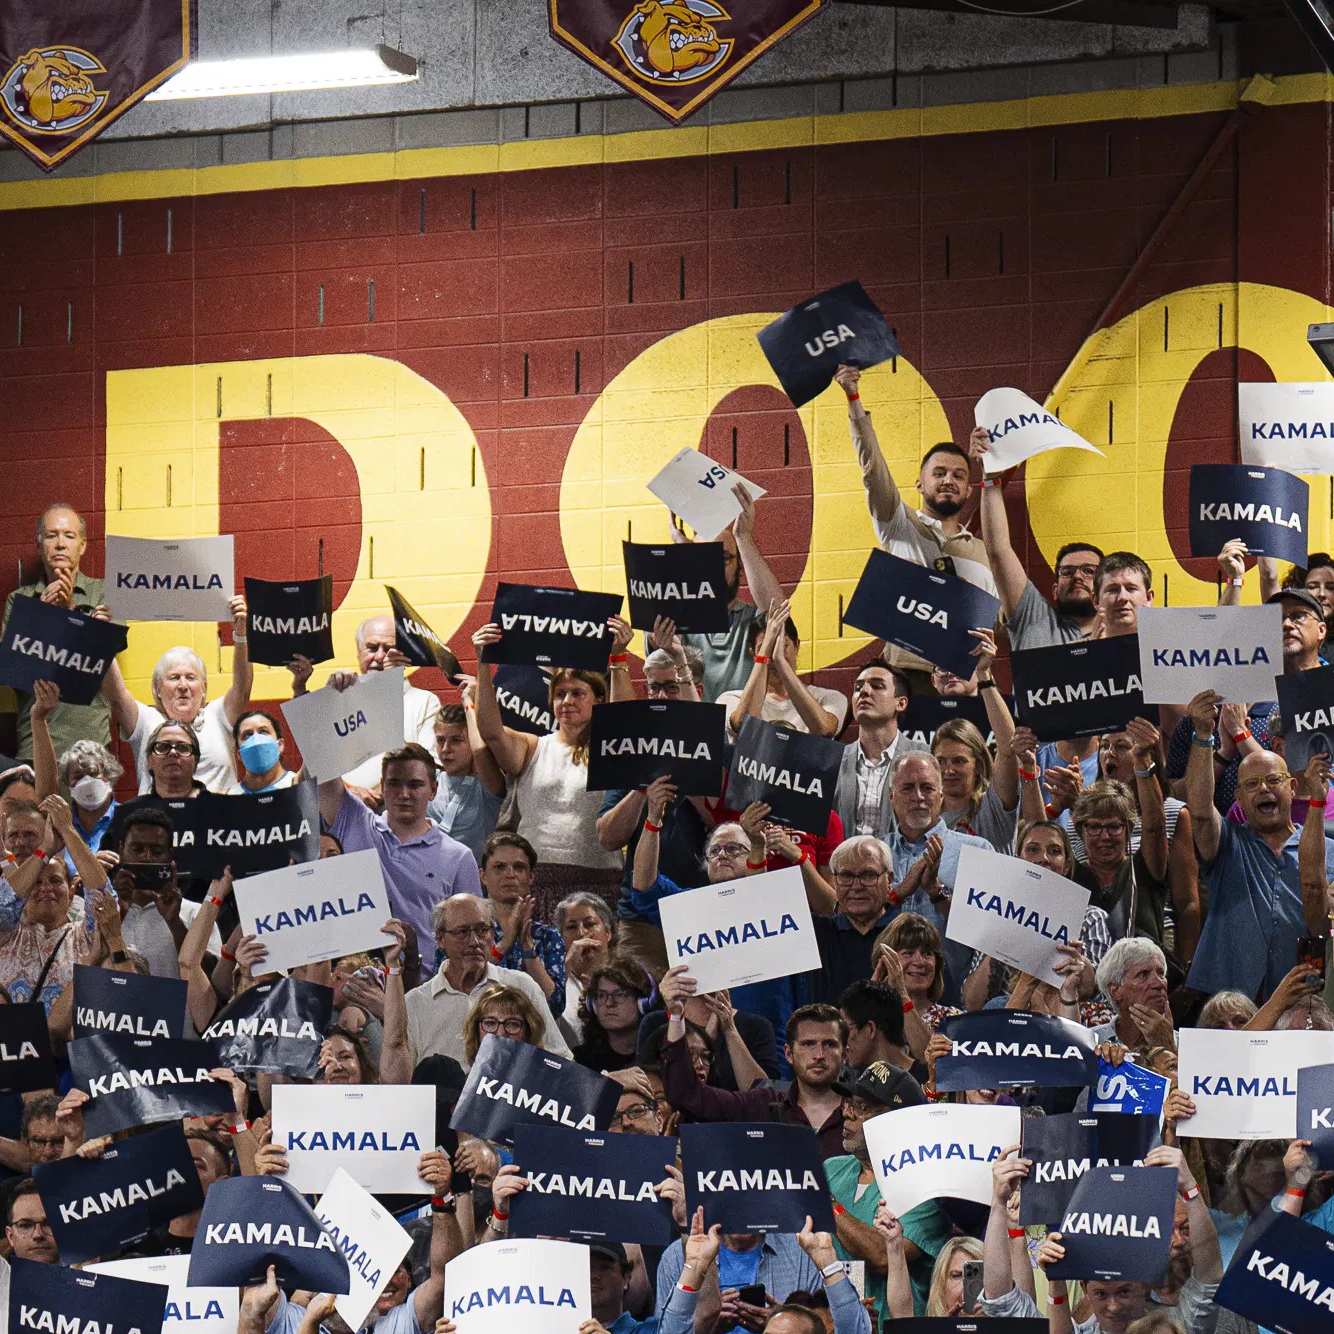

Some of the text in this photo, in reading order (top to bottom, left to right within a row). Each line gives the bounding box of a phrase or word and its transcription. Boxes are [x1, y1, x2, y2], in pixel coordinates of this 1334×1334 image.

[805, 322, 859, 356] USA
[987, 412, 1067, 443] KAMAL
[698, 465, 733, 490] SA
[1199, 502, 1302, 533] KAMALA
[117, 571, 221, 590] KAMALA
[630, 579, 716, 600] KAMALA
[252, 612, 329, 635] KAMALA
[501, 612, 605, 639] KAMALA
[896, 596, 949, 630] USA
[12, 634, 105, 675] KAMALA
[1153, 646, 1268, 667] KAMALA
[1027, 675, 1143, 708] KAMALA
[333, 710, 367, 737] USA
[495, 687, 560, 735] KAMAL
[600, 737, 711, 761] KAMALA
[737, 755, 823, 798] KAMALA
[207, 821, 311, 847] KAMALA
[256, 892, 376, 934] KAMALA
[967, 887, 1068, 943] KAMALA
[676, 913, 799, 955] KAMALA
[77, 1006, 170, 1038] KAMALA
[202, 1017, 316, 1040] KAMALA
[951, 1040, 1084, 1060] KAMALA
[88, 1066, 215, 1098] KAMALA
[476, 1076, 596, 1132] KAMALA
[288, 1131, 420, 1151] KAMALA
[881, 1143, 1003, 1176] KAMALA
[58, 1168, 186, 1224] KAMALA
[527, 1171, 660, 1202] KAMALA
[698, 1170, 819, 1192] KAMALA
[204, 1223, 336, 1252] KAMALA
[1063, 1212, 1161, 1238] KAMALA
[164, 1300, 225, 1320] ALA
[452, 1285, 576, 1319] KAMALA
